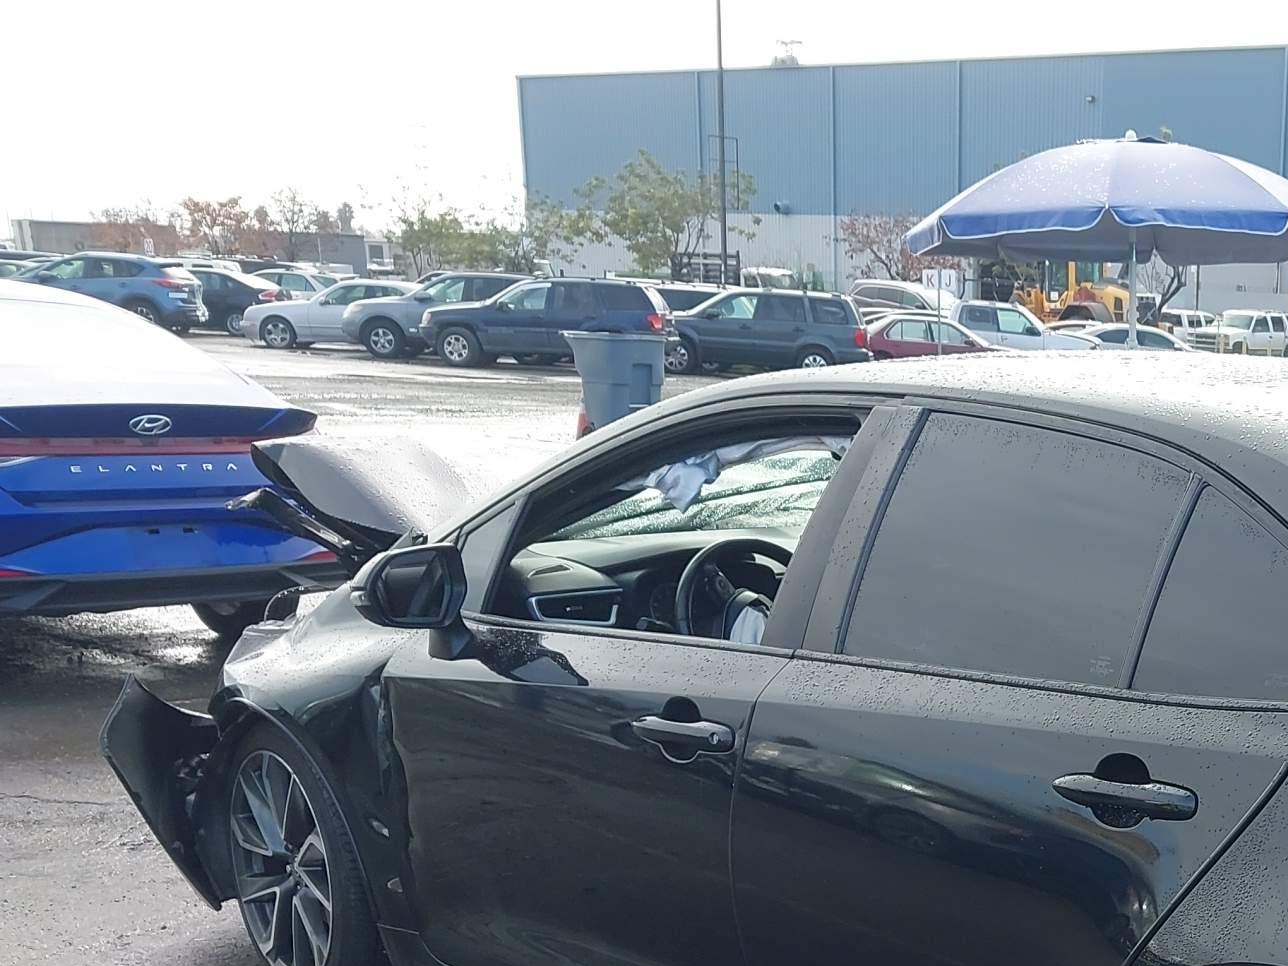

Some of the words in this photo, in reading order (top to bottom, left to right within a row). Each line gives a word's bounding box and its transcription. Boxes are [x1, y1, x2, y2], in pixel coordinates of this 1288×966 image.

[926, 273, 935, 288] K
[945, 273, 951, 288] J
[70, 462, 238, 473] ELANTRA
